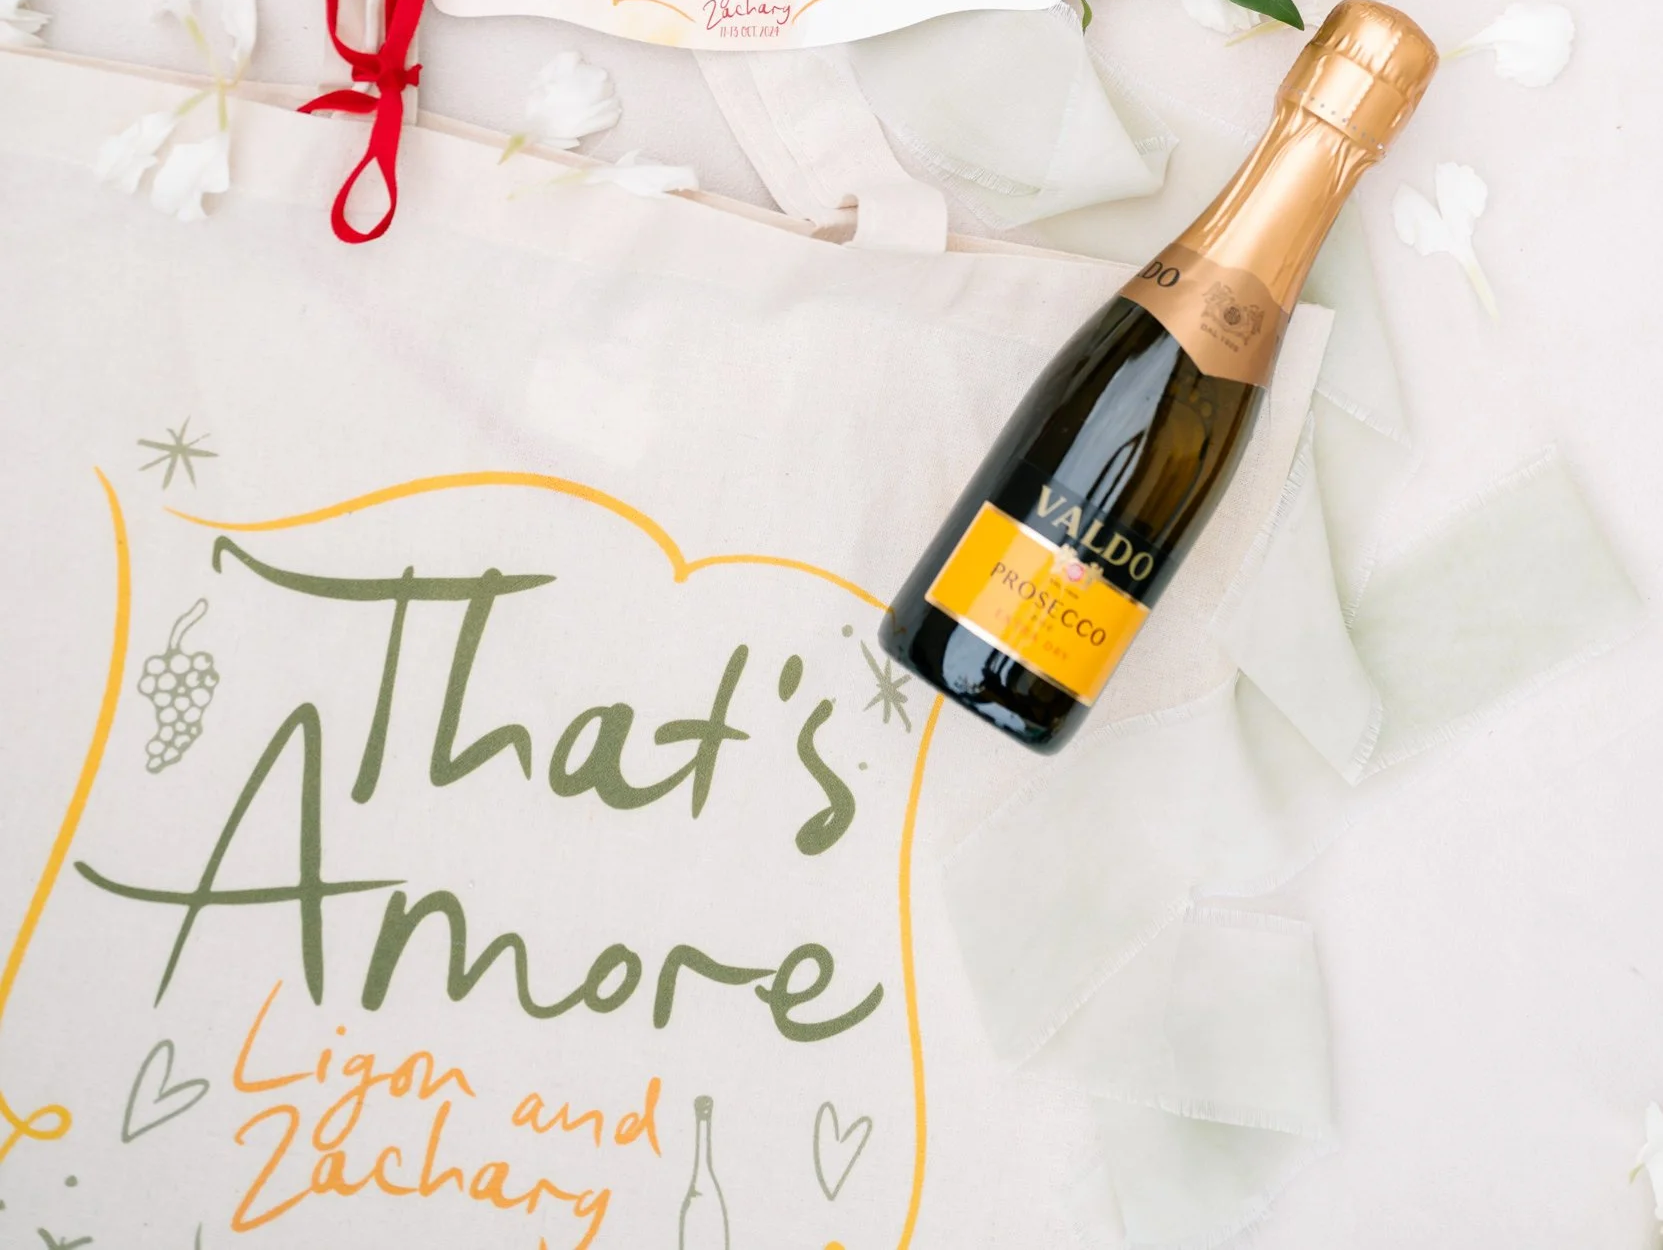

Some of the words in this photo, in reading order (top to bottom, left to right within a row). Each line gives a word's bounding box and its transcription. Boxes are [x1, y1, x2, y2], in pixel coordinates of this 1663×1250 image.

[1139, 261, 1181, 288] DO
[990, 561, 1108, 647] PROSECCO
[1036, 484, 1155, 582] VALDO
[211, 534, 857, 856] That's
[73, 702, 885, 1042] Amore
[232, 980, 476, 1149] Ligon
[511, 1076, 663, 1156] and
[230, 1100, 612, 1250] Zachary
